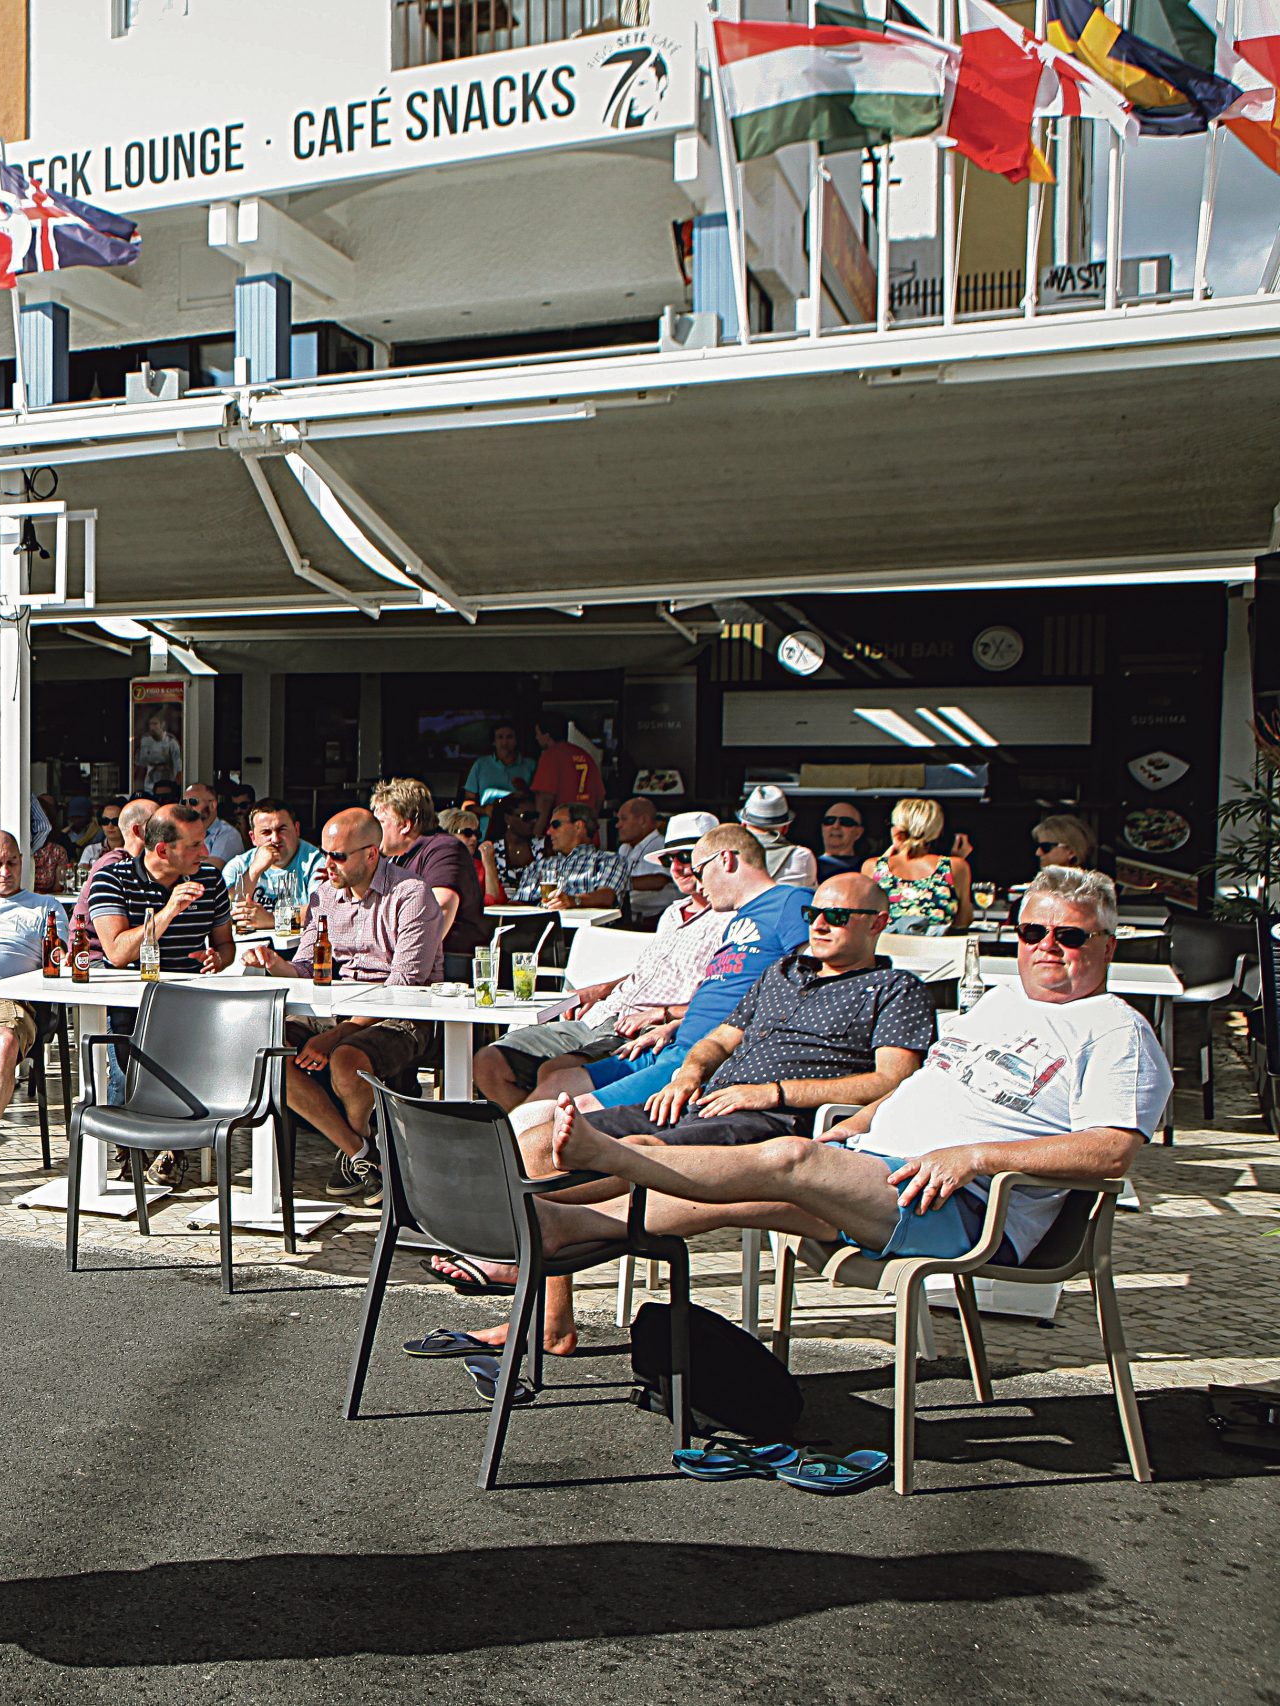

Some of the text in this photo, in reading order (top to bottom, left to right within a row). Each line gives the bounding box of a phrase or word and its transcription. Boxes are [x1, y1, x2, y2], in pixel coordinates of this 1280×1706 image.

[293, 64, 576, 160] CAFÉ SNACKS
[105, 122, 244, 192] LOUNGE
[911, 640, 954, 657] BAR
[575, 763, 588, 793] 7
